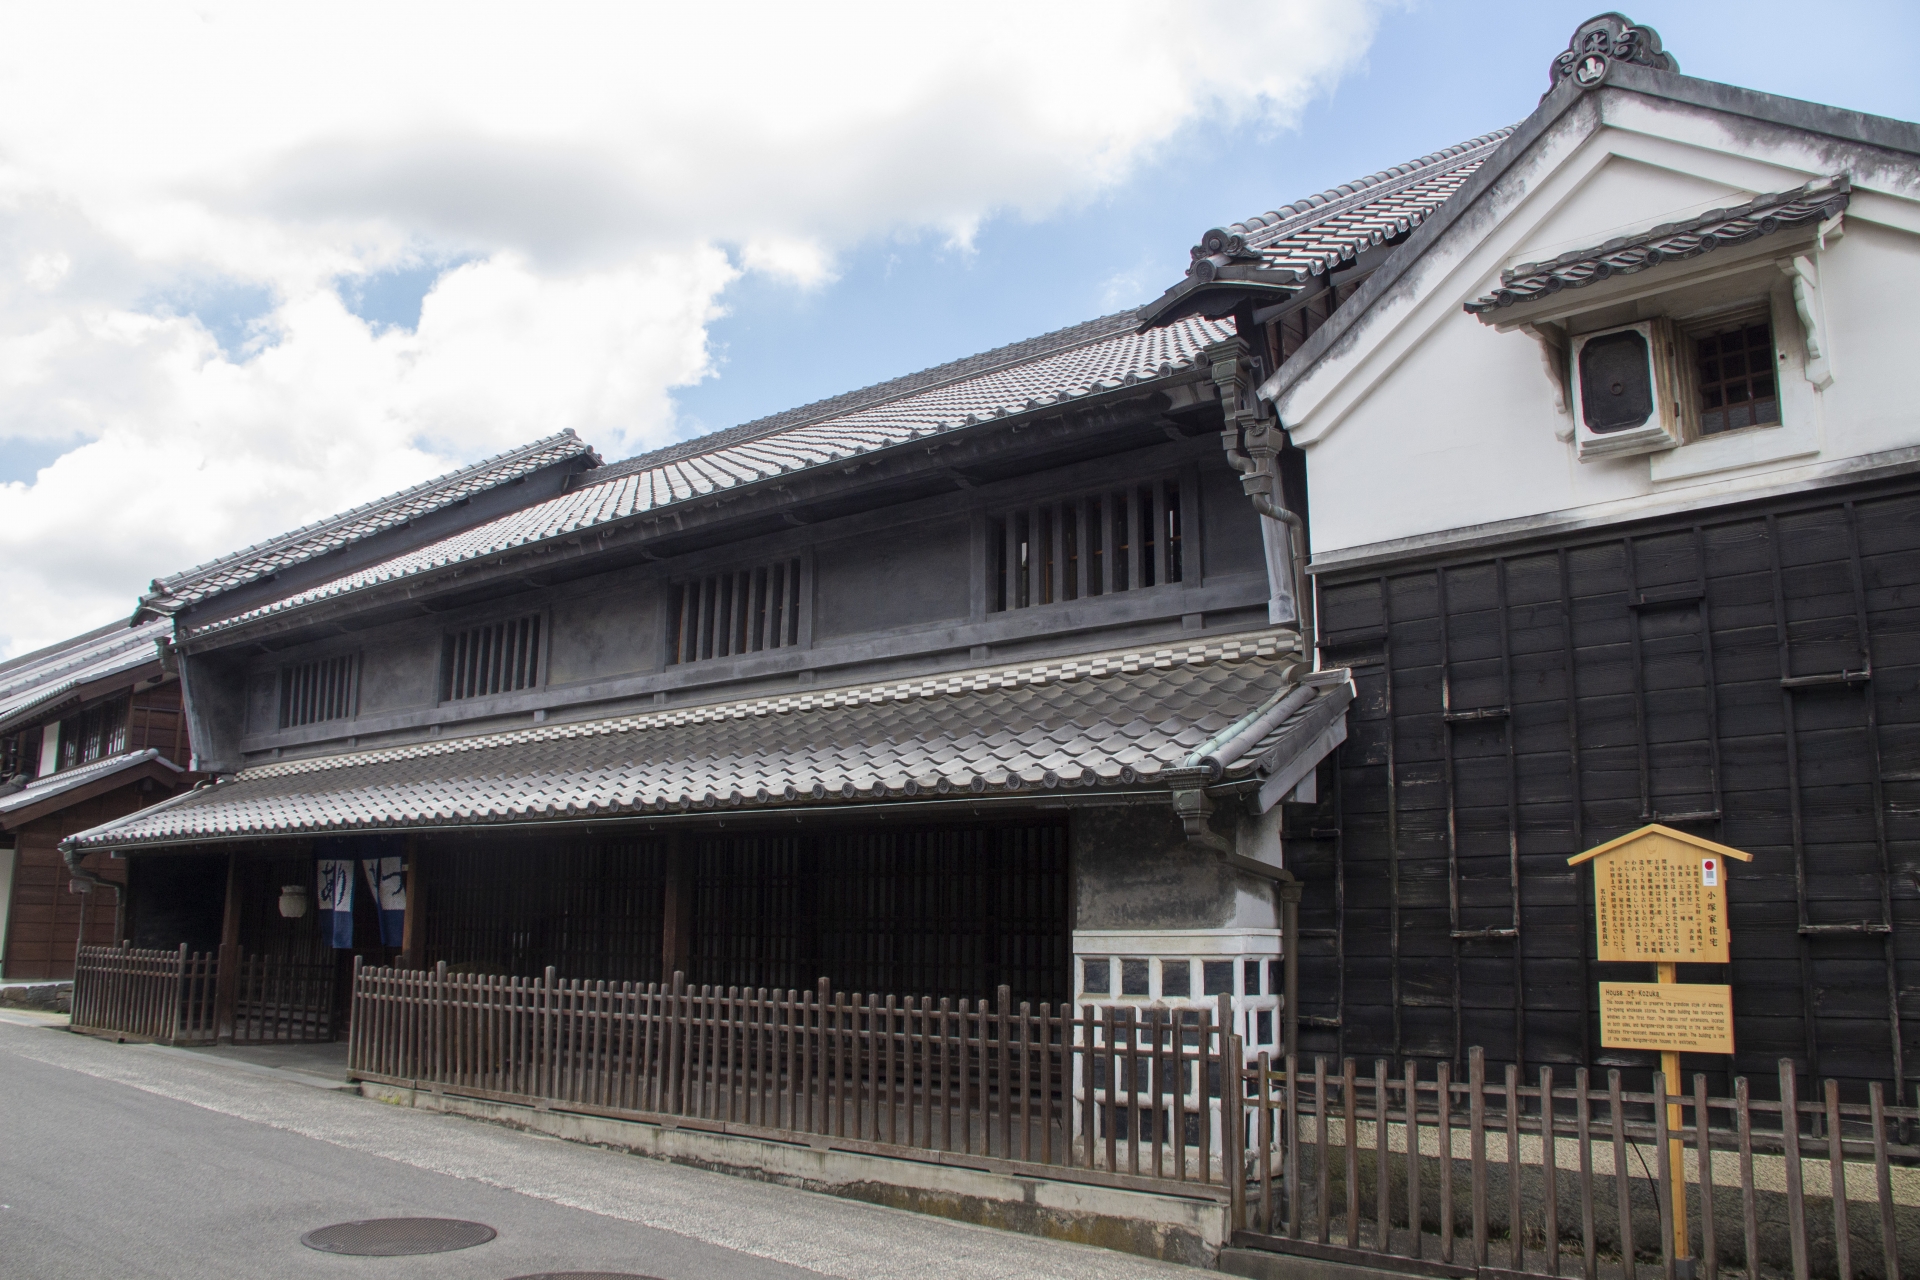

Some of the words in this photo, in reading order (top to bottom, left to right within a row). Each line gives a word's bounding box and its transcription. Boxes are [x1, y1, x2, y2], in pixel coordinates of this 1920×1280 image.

[1578, 58, 1604, 82] 山
[1707, 891, 1718, 947] 小塚家住宅
